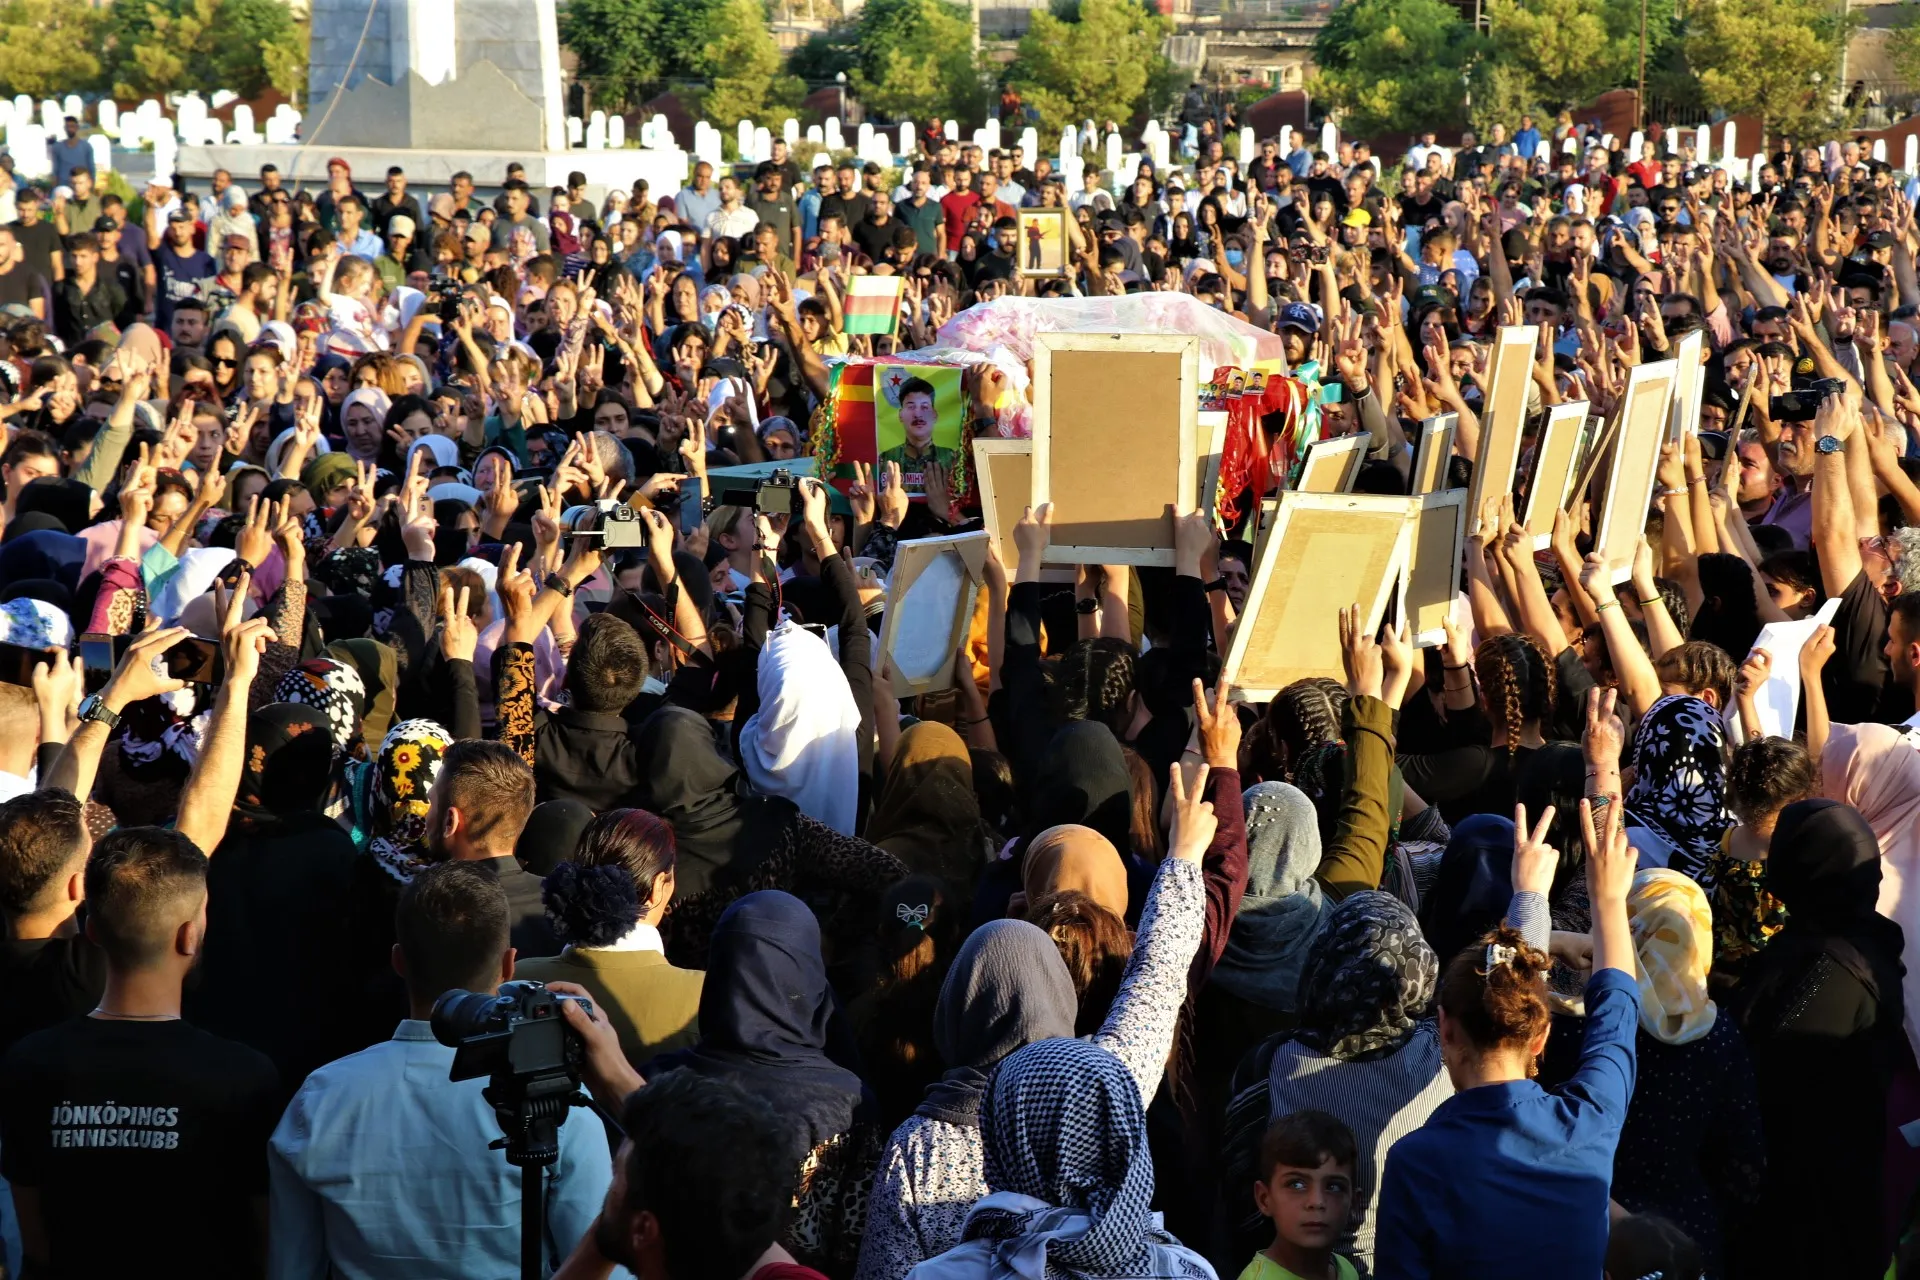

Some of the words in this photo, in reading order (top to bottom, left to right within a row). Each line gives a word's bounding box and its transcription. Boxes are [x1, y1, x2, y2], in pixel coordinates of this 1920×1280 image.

[648, 615, 665, 630] EOS
[662, 627, 670, 635] R
[51, 1100, 179, 1127] JÖNKÖPINGS
[51, 1129, 180, 1150] TENNISKLUBB
